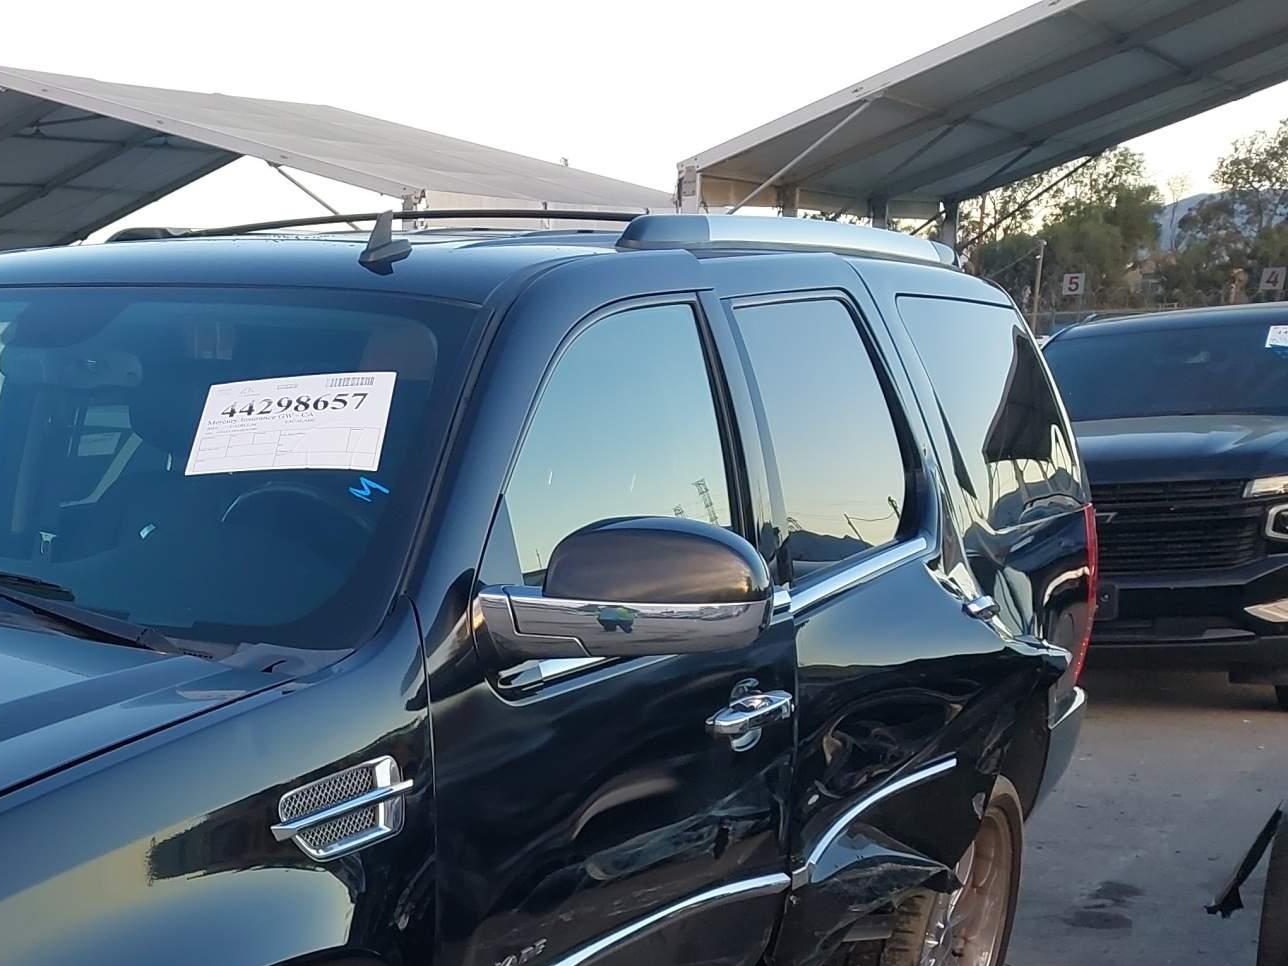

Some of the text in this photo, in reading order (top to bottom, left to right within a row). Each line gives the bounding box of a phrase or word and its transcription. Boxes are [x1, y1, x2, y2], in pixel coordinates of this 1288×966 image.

[1068, 276, 1080, 292] 5
[1266, 270, 1279, 287] 4
[220, 392, 369, 418] 44298657
[207, 418, 237, 427] Mercury
[240, 414, 276, 423] Insurance
